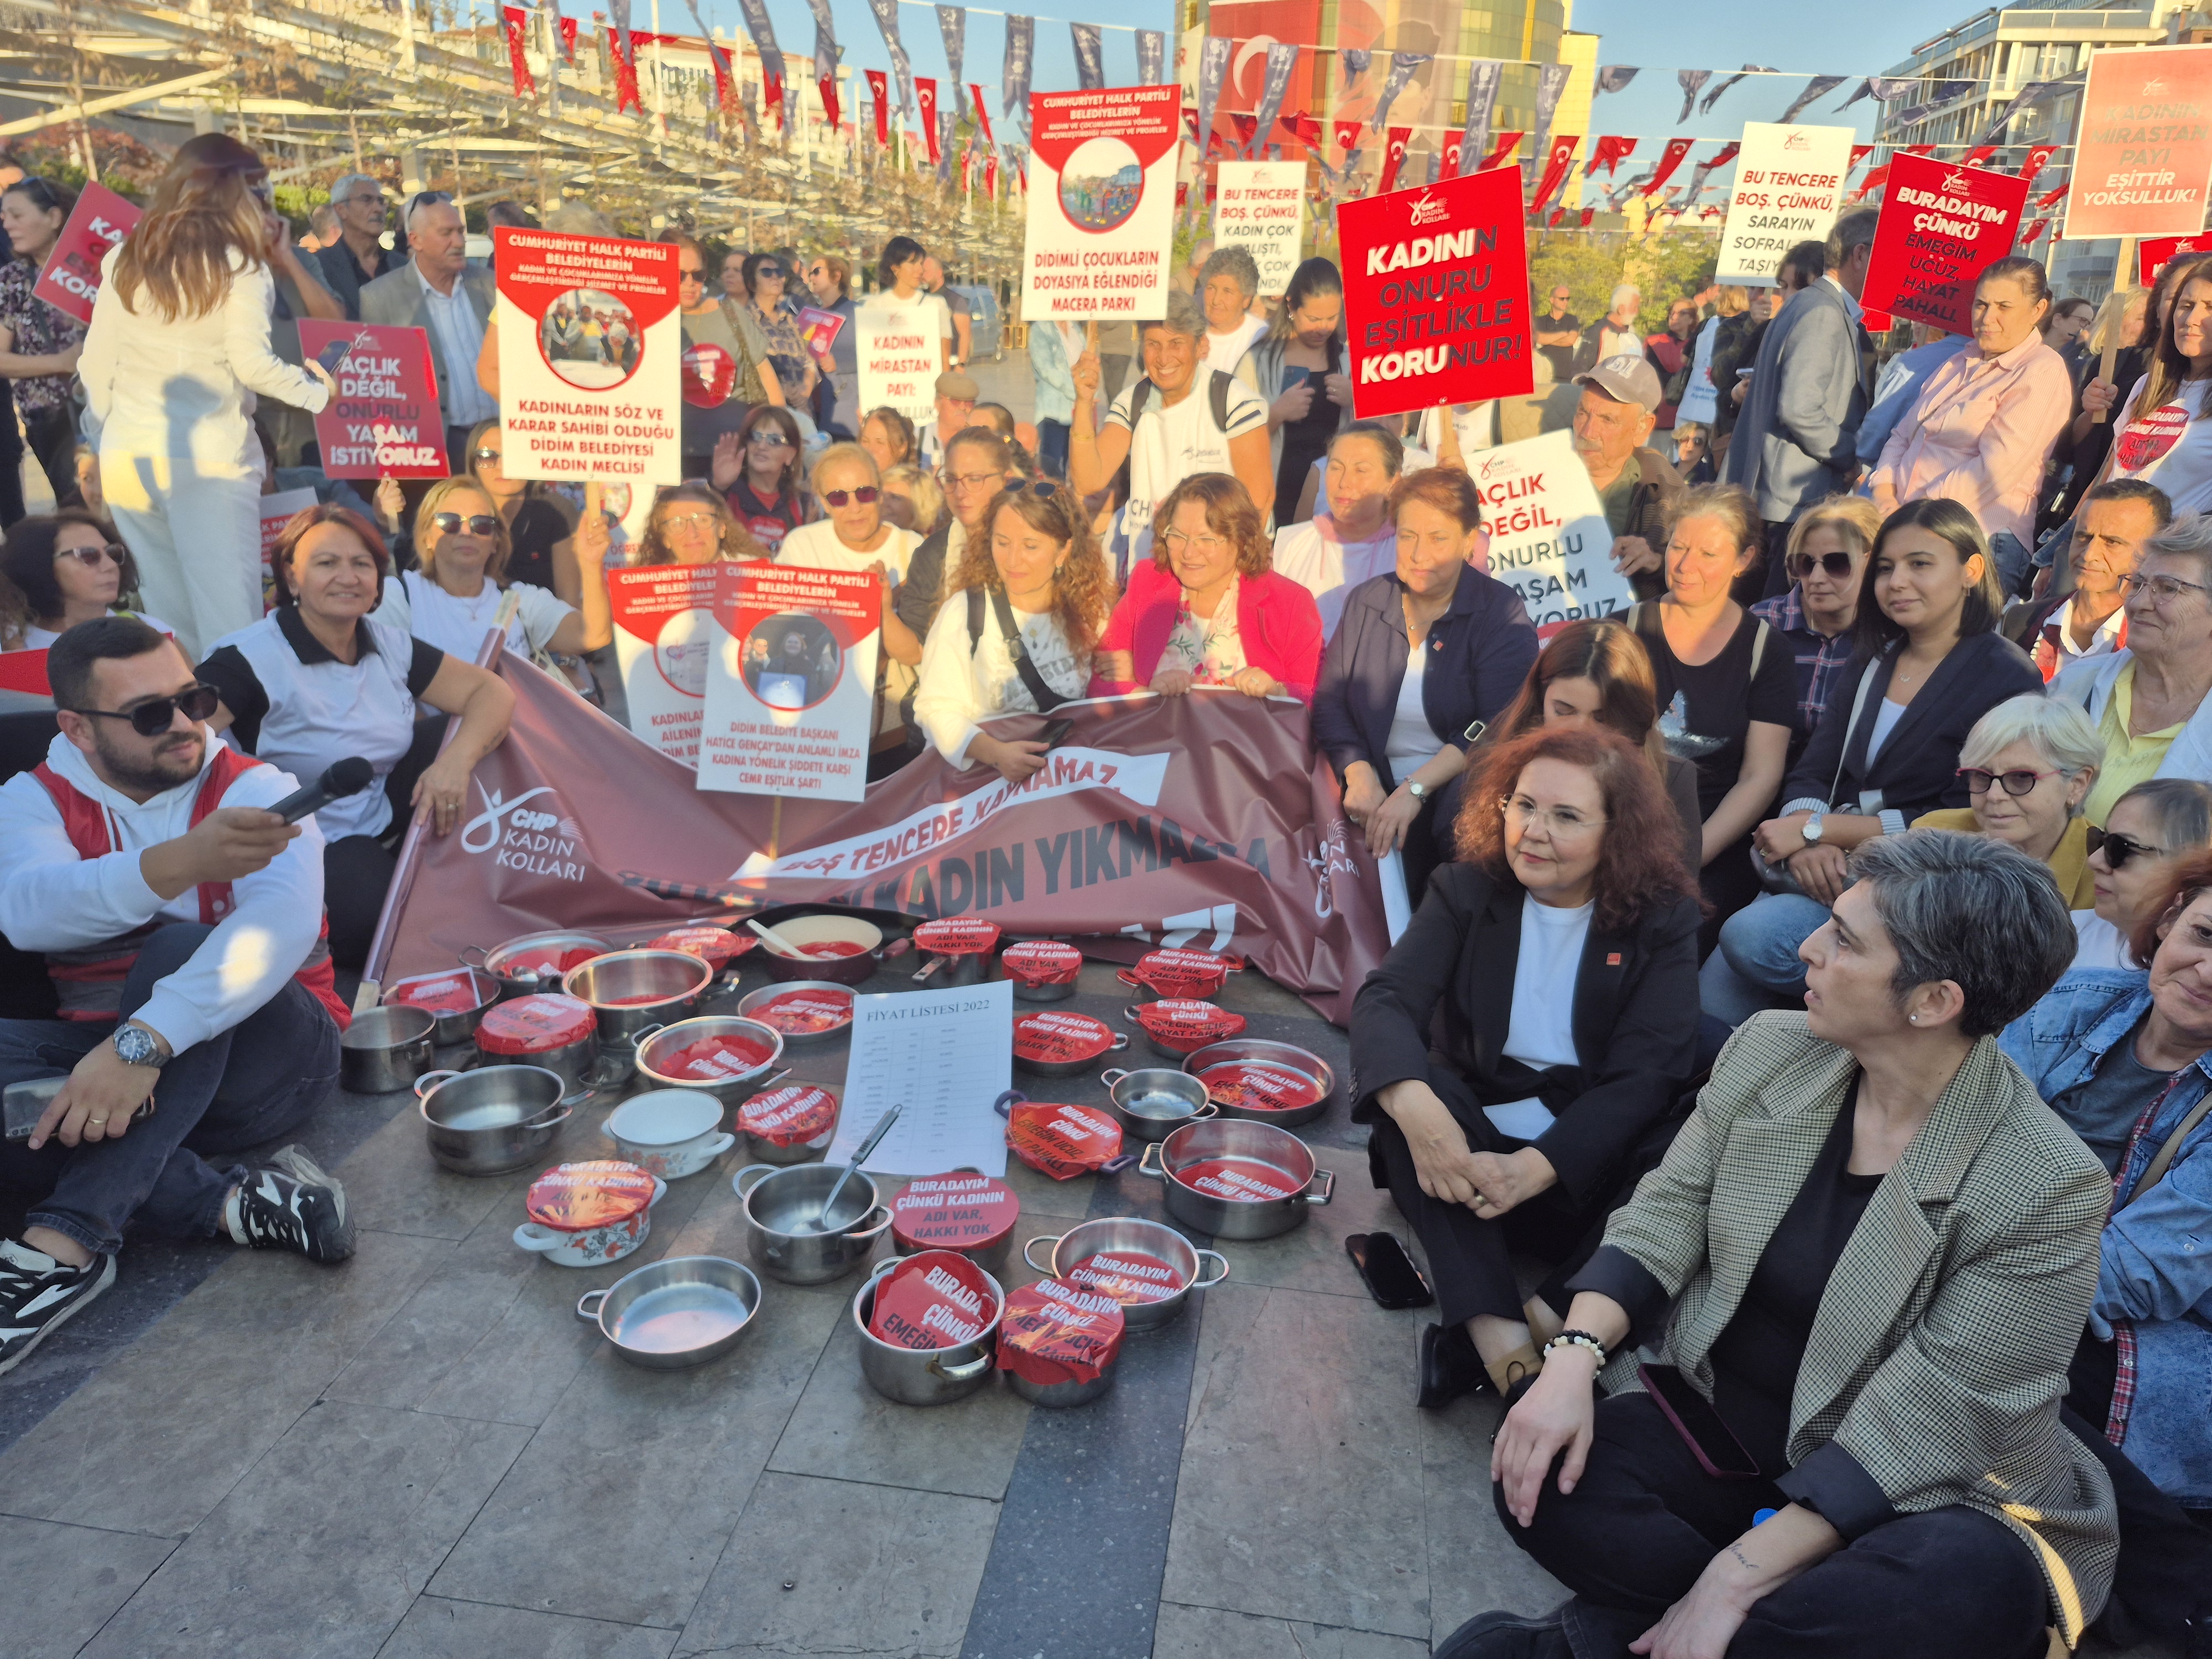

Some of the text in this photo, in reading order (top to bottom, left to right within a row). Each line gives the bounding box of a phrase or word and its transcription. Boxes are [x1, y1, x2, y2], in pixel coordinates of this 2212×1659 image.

[1043, 88, 1171, 108] CUMHURİYET HALK PARTİLİ
[1070, 104, 1141, 120] BELEDİYELERİN
[2105, 102, 2201, 122] KADININ
[2089, 124, 2210, 144] MİRASTAN
[2119, 148, 2171, 166] PAYI
[1743, 170, 1839, 189] BU TENCERE
[2105, 169, 2176, 191] EŞİTTİR
[1224, 189, 1299, 200] BU TENCERE
[1735, 192, 1833, 213] BOŞ. ÇÜNKÜ,
[2083, 189, 2197, 206] YOKSULLUK!
[1220, 204, 1298, 221] BOŞ. ÇÜNKÜ,
[1896, 186, 2008, 225] BURADAYIM
[1224, 225, 1295, 238] KADIN ÇOK
[1747, 215, 1815, 231] SARAYIN
[1913, 212, 1980, 241] ÇÜNKÜ
[509, 234, 666, 261] CUMHURİYET HALK PARTİLİ
[1366, 225, 1498, 276] KADININ
[1905, 233, 1978, 262] EMEĞİM
[546, 252, 633, 272] BELEDİYELERİN
[1035, 248, 1159, 270] DİDİMLİ ÇOCUKLARIN
[1264, 261, 1292, 274] ÇOK
[519, 264, 545, 273] KADIN
[546, 266, 557, 275] VE
[1034, 270, 1157, 290] DOYASIYA EĞLENDİĞİ
[1379, 264, 1492, 309] ONURU
[1902, 276, 1960, 300] HAYAT
[1052, 296, 1135, 312] MACERA PARKI
[1893, 294, 1957, 323] PAHALI.
[1364, 298, 1514, 351] EŞİTLİKLE
[873, 336, 925, 350] KADININ
[340, 356, 401, 379] AÇLIK
[869, 357, 931, 374] MİRASTAN
[1361, 333, 1522, 385] KORUNUR!
[341, 375, 406, 401] DEĞİL,
[336, 403, 420, 420] ONURLU
[519, 400, 664, 420] KADINLARIN SÖZ VE
[346, 424, 418, 446] YAŞAM
[509, 419, 674, 440] KARAR SAHİBİ OLDUĞU
[330, 445, 440, 466] İSTİYORUZ.
[530, 438, 654, 457] DİDİM BELEDİYESİ
[541, 458, 644, 474] KADIN MECLİSİ
[619, 568, 689, 584] CUMHURİYET
[726, 565, 870, 588] CUMHURİYET HALK PARTİLİ
[757, 581, 837, 598] BELEDİYELERİN
[1513, 568, 1587, 606] AŞAM
[731, 721, 757, 734] DİDİM
[800, 727, 839, 742] BAŞKANI
[706, 736, 860, 760] HATİCE GENÇAY'DAN ANLAMLI İMZA
[712, 754, 852, 775] KADINA YÖNELİK ŞİDDETE KARŞI
[739, 773, 822, 790] CEMR EŞİTLİK ŞARTI
[511, 808, 557, 831] CHP
[504, 828, 575, 857] KADIN
[780, 853, 844, 876] BOŞ
[849, 807, 963, 870] TENCERE
[496, 848, 585, 882] KOLLARI
[874, 842, 1024, 919] KADIN
[916, 926, 950, 936] ÇÜNKÜ
[1145, 956, 1223, 970] ÇÜNKÜ KADININ
[1159, 950, 1216, 962] BURADAYIM
[867, 999, 990, 1022] FİYAT LİSTESİ 2022
[1171, 1010, 1207, 1020] ÇÜNKÜ
[1019, 1020, 1102, 1041] ÇÜNKÜ KADININ
[1037, 1013, 1099, 1030] BURADAYIM
[1016, 1040, 1048, 1051] HAKKI
[1030, 1032, 1051, 1041] ADI
[1240, 1067, 1306, 1091] BURADAYIM
[1242, 1074, 1285, 1093] ÇÜNKÜ
[741, 1087, 802, 1117] BURADAYIM
[780, 1088, 825, 1120] KADININ
[1047, 1120, 1092, 1140] ÇÜNKÜ
[1057, 1105, 1118, 1138] BURADAYIM
[1016, 1119, 1084, 1159] EMEĞİM UCUZ,
[910, 1177, 989, 1192] BURADAYIM
[1193, 1177, 1240, 1195] ÇÜNKÜ
[1217, 1170, 1289, 1197] BURADAYIM
[896, 1191, 1005, 1211] ÇÜNKÜ KADININ
[923, 1209, 983, 1222] ADI VAR,
[914, 1223, 994, 1238] HAKKI YOK.
[1091, 1254, 1172, 1281] BURADAYIM
[1035, 1279, 1121, 1314] BURADAYIM
[1120, 1279, 1180, 1298] KADININ
[921, 1303, 980, 1343] ÇÜNKÜ
[1039, 1302, 1098, 1327] ÇÜNKÜ
